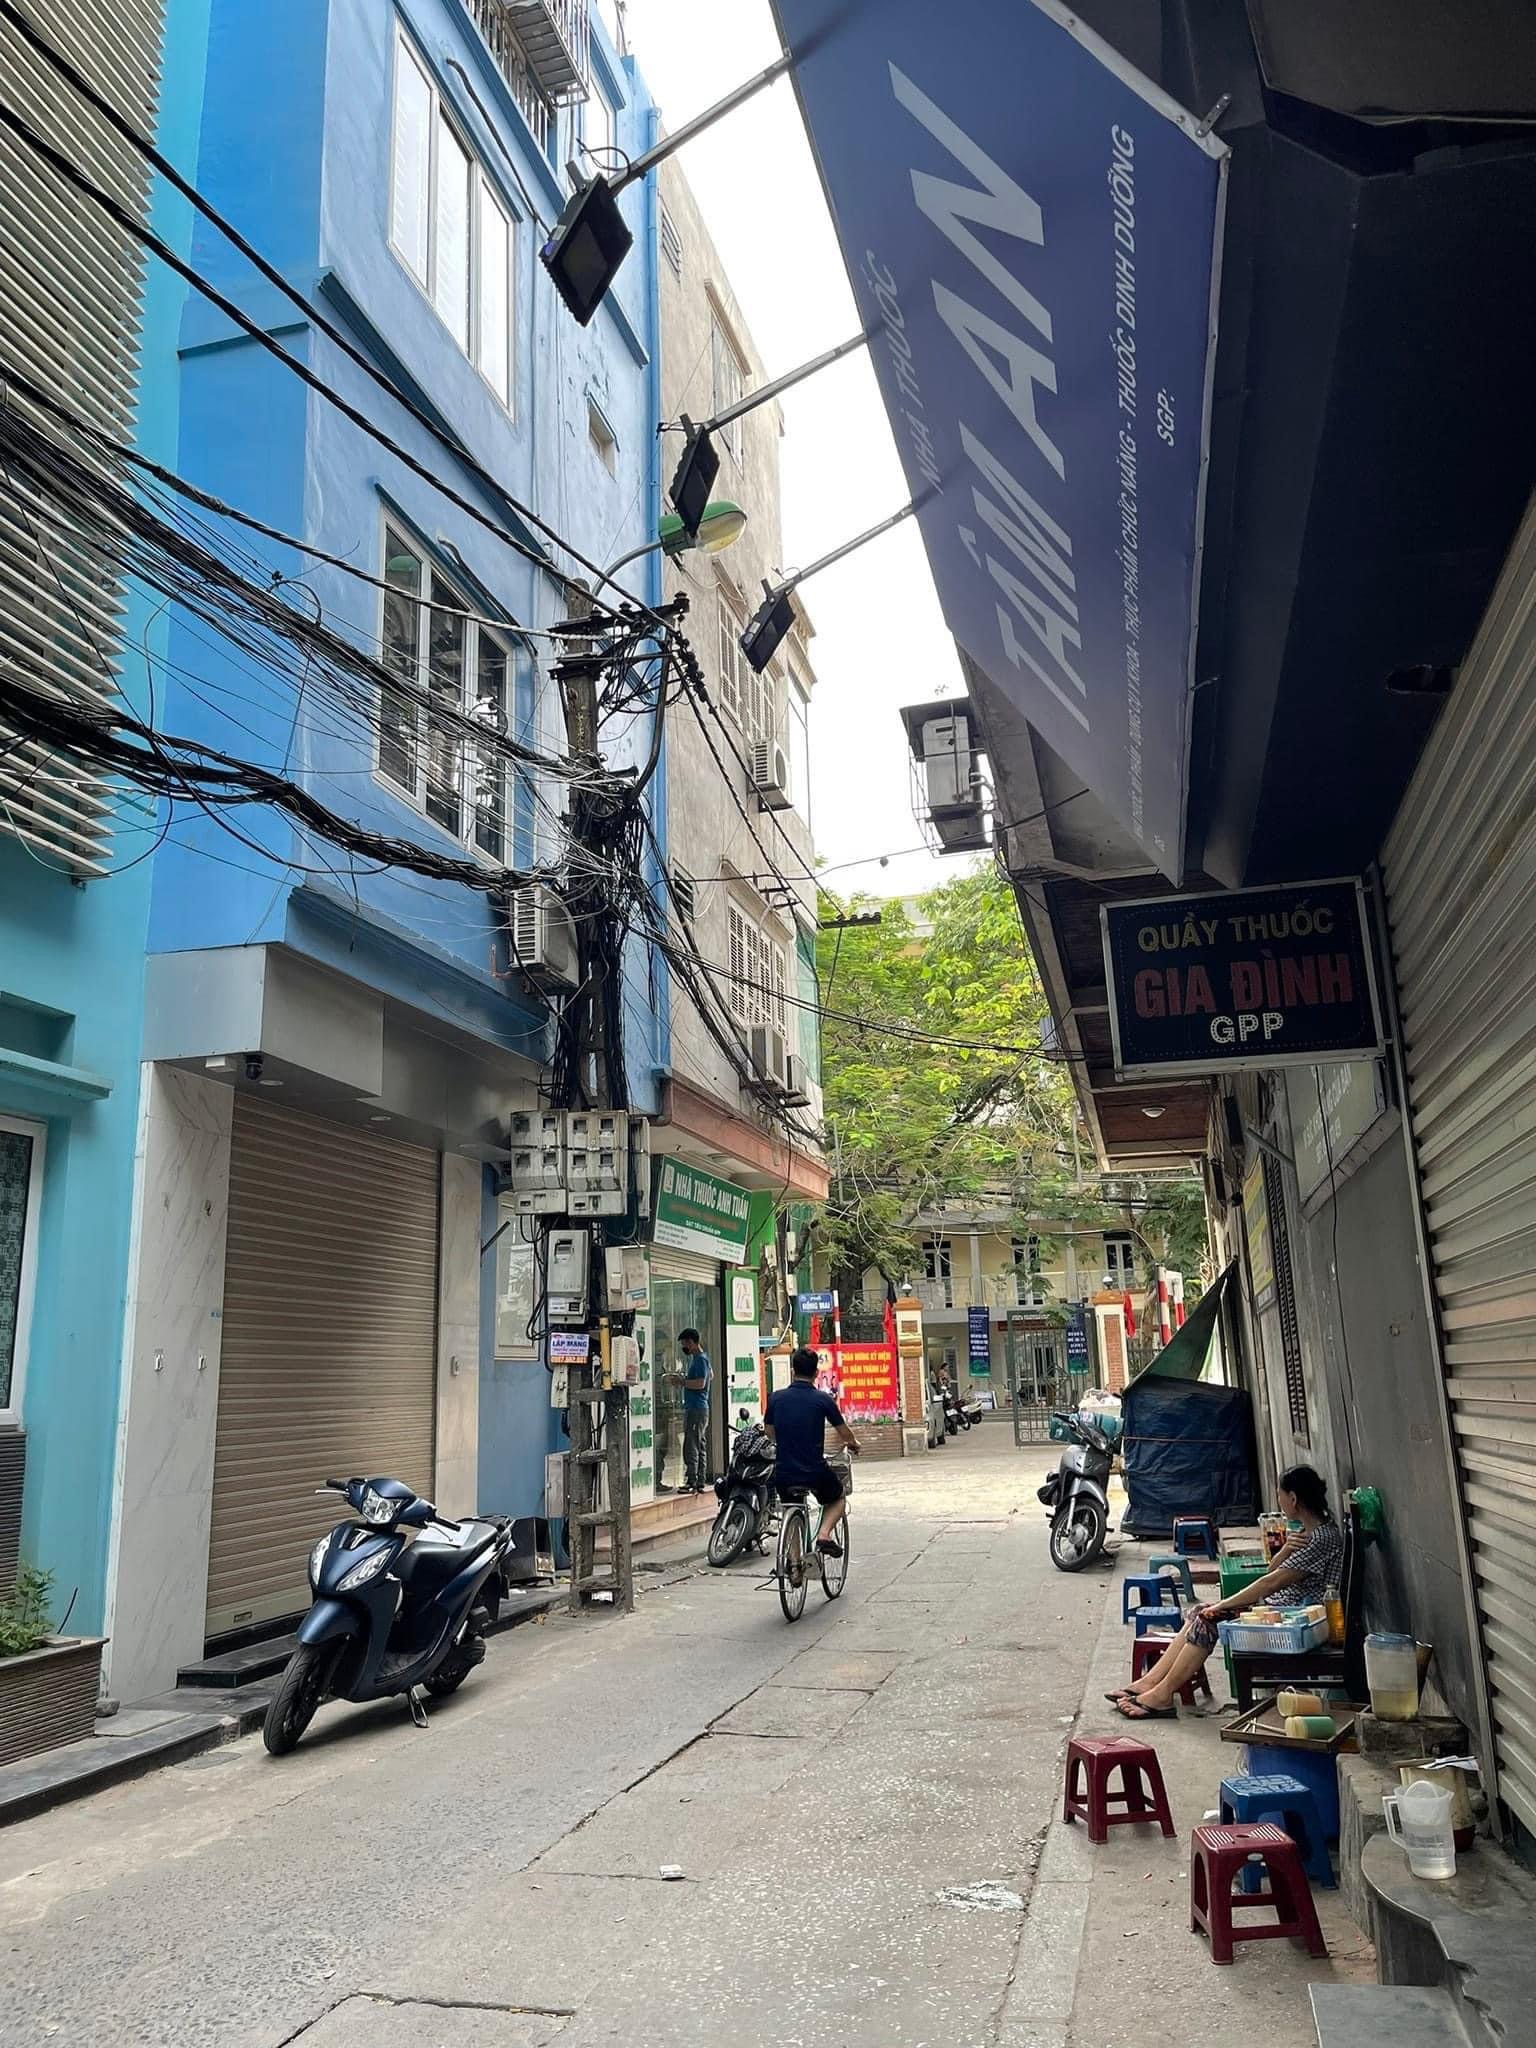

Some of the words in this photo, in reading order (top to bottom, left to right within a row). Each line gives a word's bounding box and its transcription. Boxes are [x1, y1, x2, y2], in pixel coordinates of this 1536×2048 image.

[1107, 124, 1135, 253] DƯỠNG
[888, 59, 1066, 483] AN
[1115, 249, 1136, 331] DINH
[861, 248, 923, 408] THUỐC
[1109, 327, 1137, 417] THUỐC
[901, 406, 944, 496] NHÀ
[1157, 387, 1175, 447] SGP:
[1115, 430, 1137, 498] NĂNG
[1117, 492, 1138, 551] CHỨC
[958, 419, 1090, 734] TÂM
[1115, 546, 1139, 600] PHẨM
[1122, 595, 1142, 641] THỰC
[1126, 644, 1141, 687] KHOA
[1137, 911, 1218, 952] QUẦY
[1228, 899, 1334, 943] THUỐC
[1134, 964, 1216, 1018] GIA
[1230, 949, 1353, 1011] ĐÌNH
[1210, 1012, 1284, 1044] GPP
[675, 1171, 692, 1201] NHÀ
[693, 1178, 717, 1209] THUỐC
[716, 1188, 732, 1215] ANH
